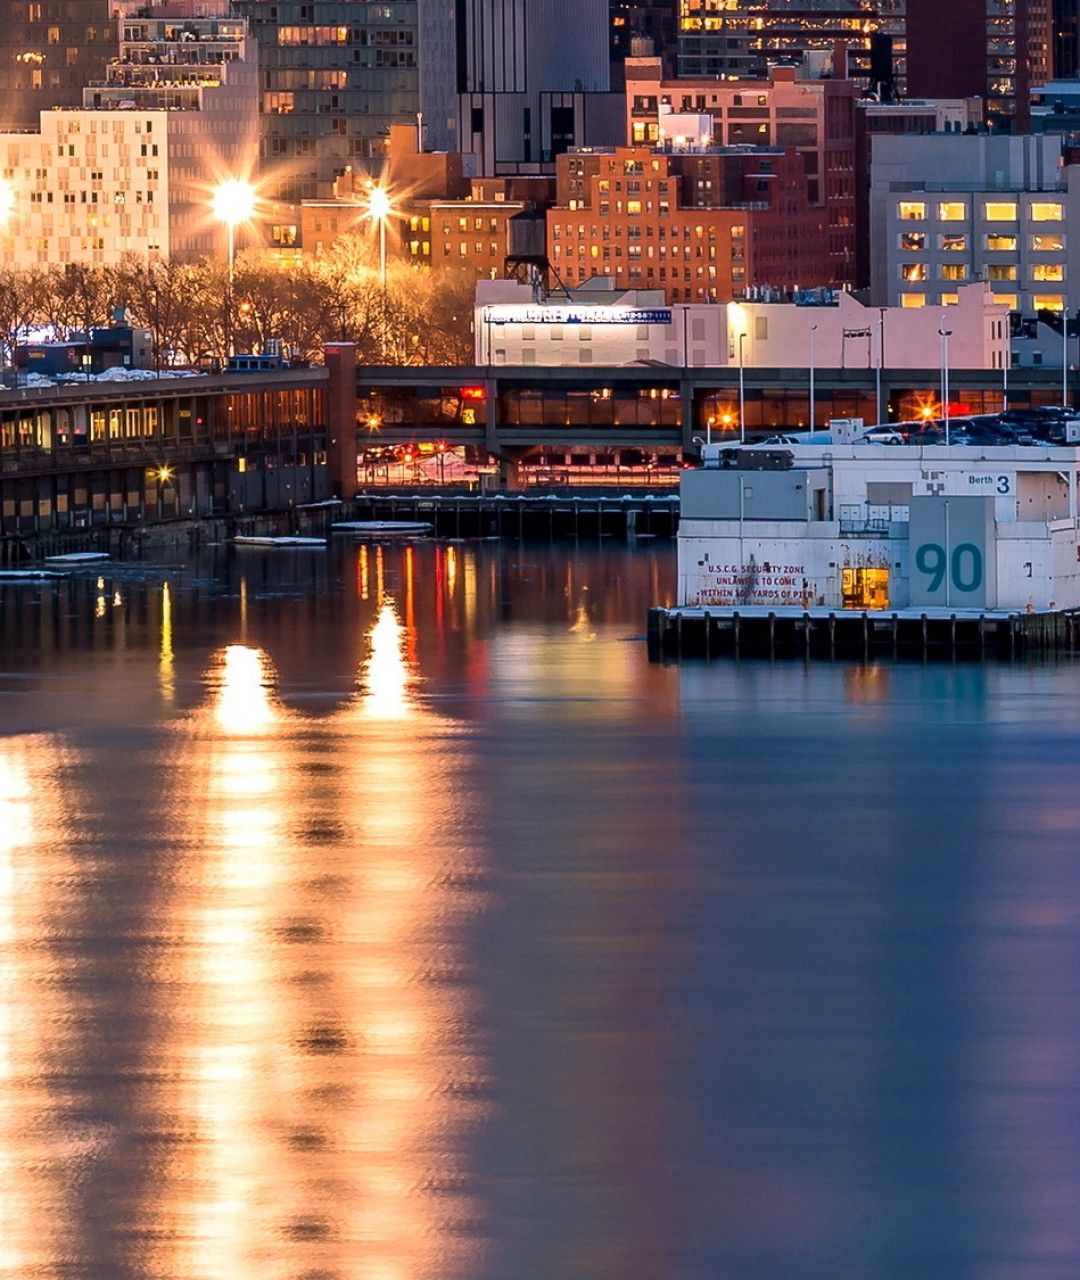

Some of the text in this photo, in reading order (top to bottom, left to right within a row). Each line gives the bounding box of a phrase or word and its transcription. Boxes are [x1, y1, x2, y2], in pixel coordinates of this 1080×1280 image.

[968, 475, 1010, 494] Berth 3
[784, 565, 805, 574] ZONE
[915, 543, 982, 593] 90
[762, 577, 772, 586] TO
[774, 577, 797, 586] COME
[700, 589, 733, 597] WITHIN
[752, 589, 779, 598] YARDS
[781, 590, 792, 598] OF
[793, 590, 814, 598] PIER
